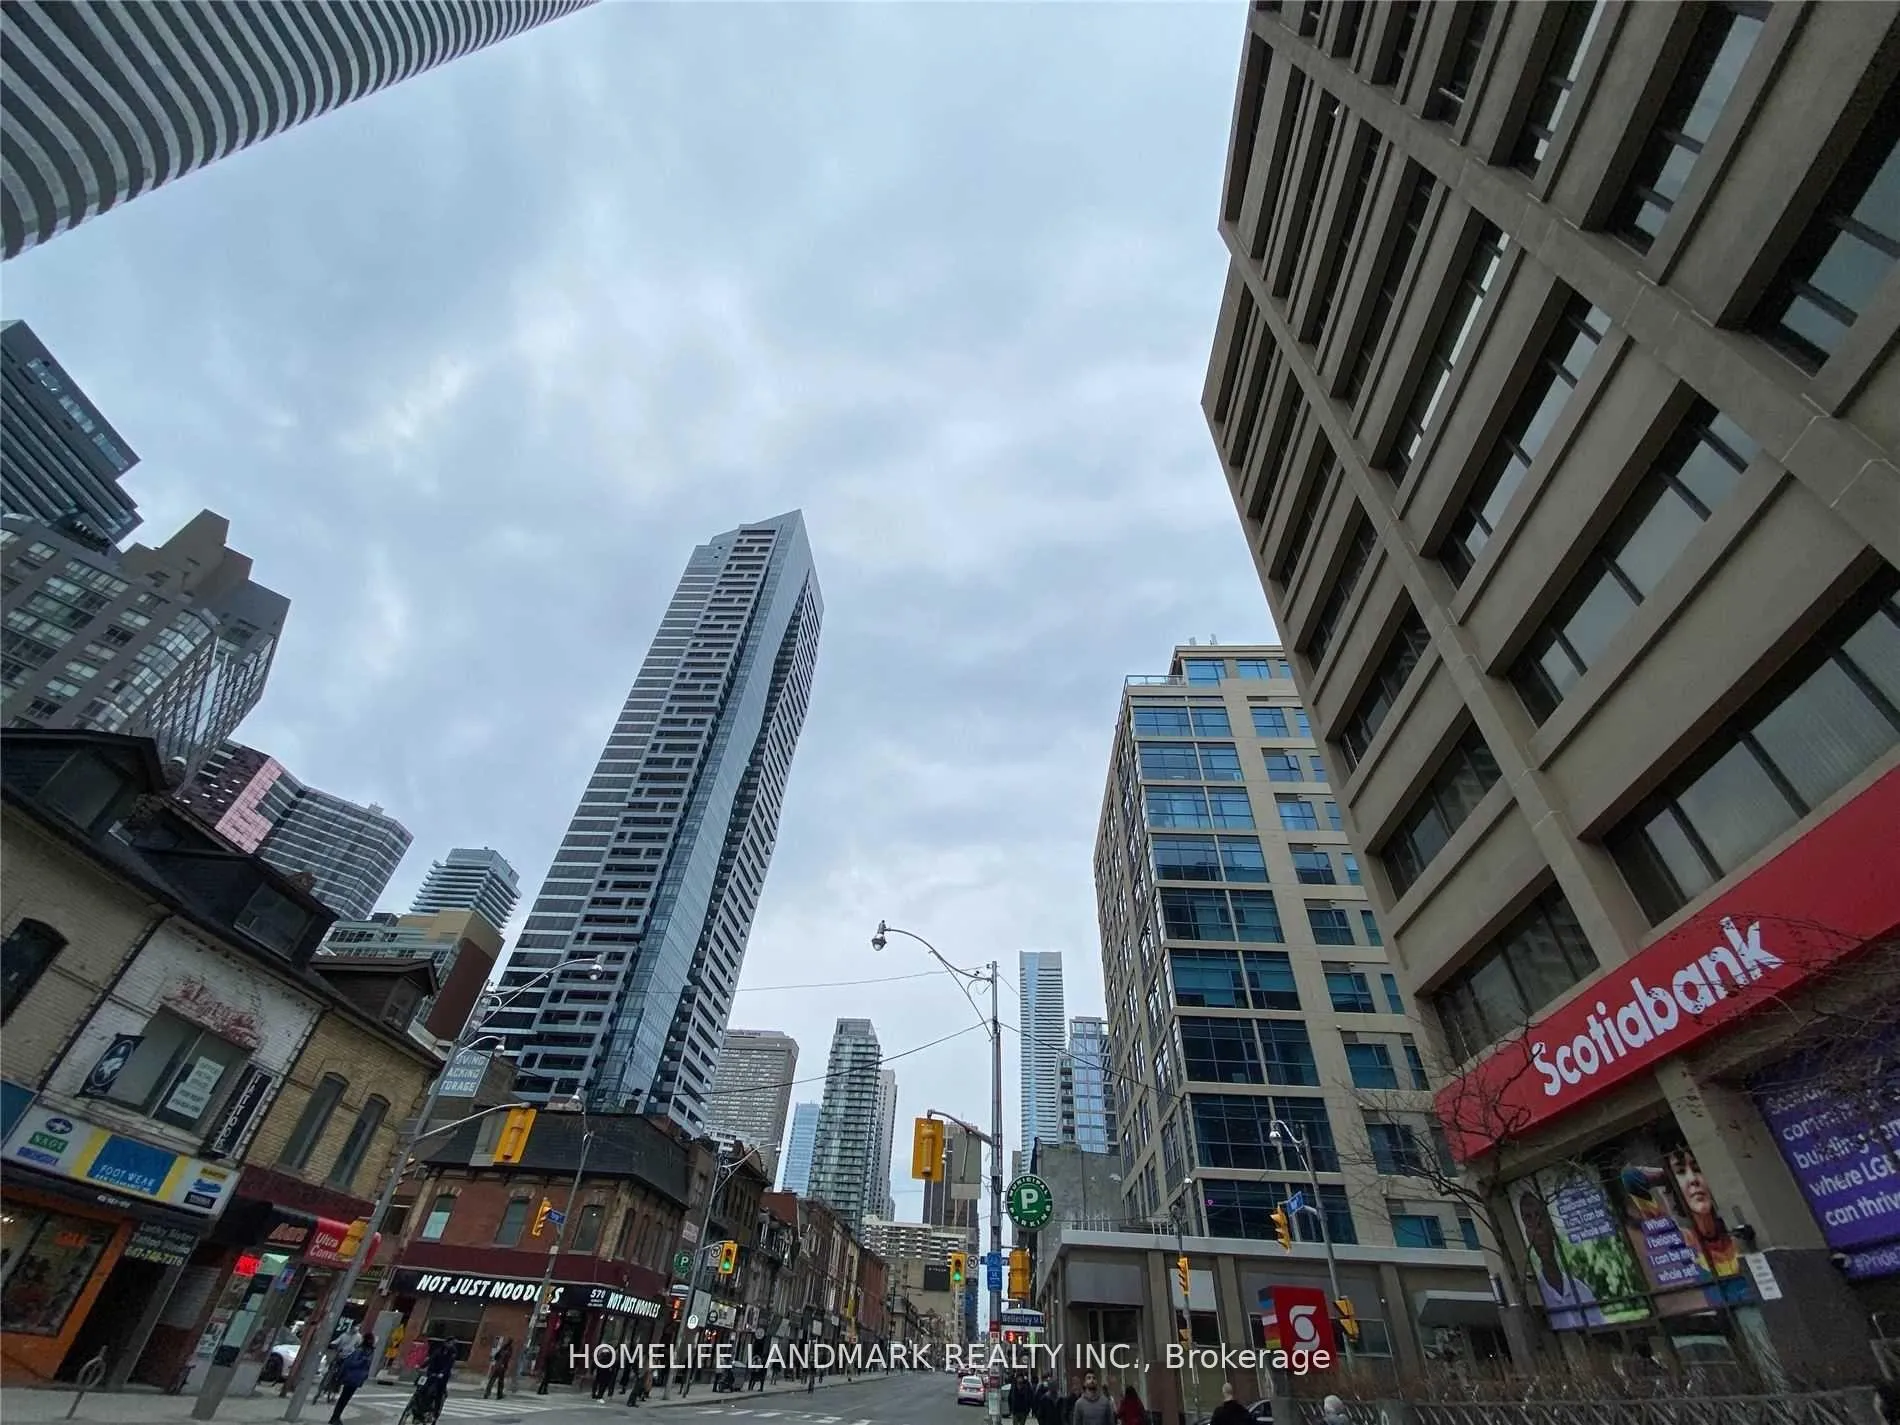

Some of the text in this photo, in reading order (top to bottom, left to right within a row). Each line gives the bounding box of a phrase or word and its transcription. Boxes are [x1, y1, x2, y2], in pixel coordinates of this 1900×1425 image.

[1531, 916, 1785, 1097] Scotiabank
[1809, 1166, 1864, 1197] where
[1020, 1189, 1039, 1210] P
[1009, 1205, 1051, 1227] PARKING
[1825, 1203, 1860, 1227] can
[315, 1232, 339, 1249] Ultra
[681, 1255, 689, 1266] P
[416, 1274, 451, 1291] NOT
[450, 1278, 491, 1298] JUST
[606, 1292, 626, 1310] NOT
[620, 1294, 637, 1313] JUST
[634, 1297, 661, 1318] NOODLES
